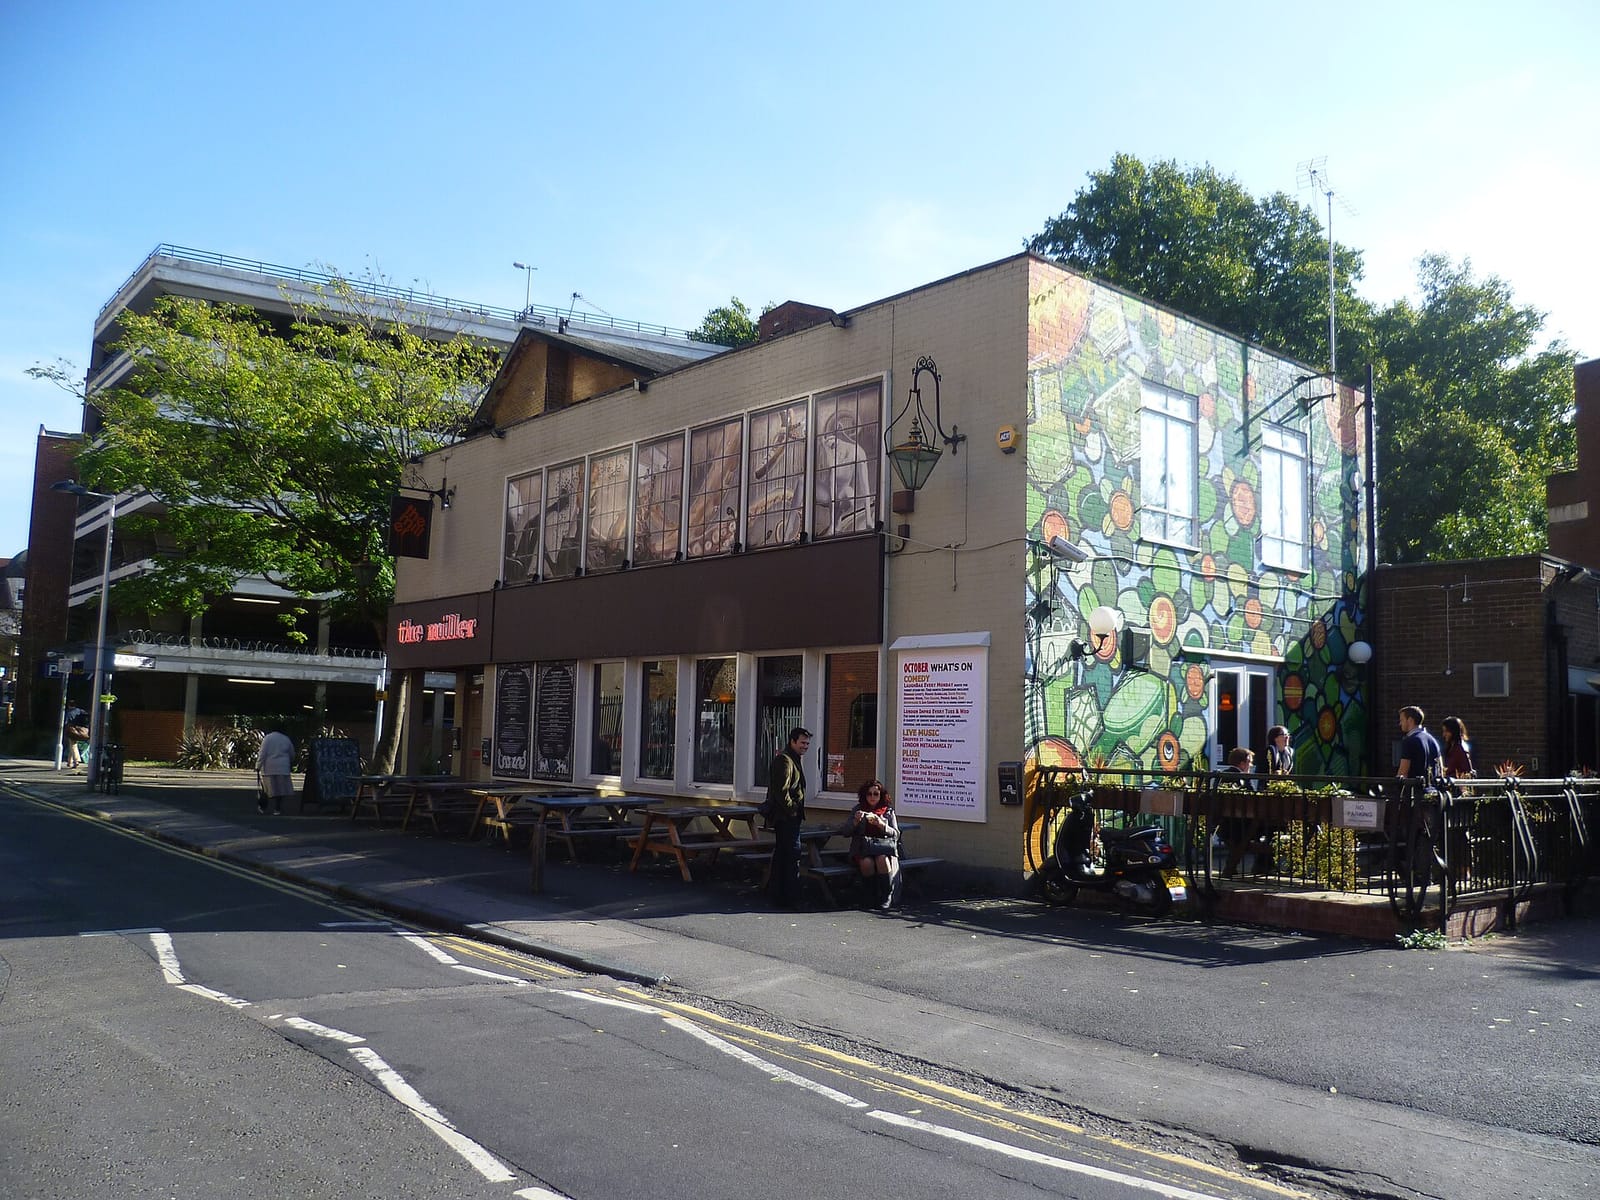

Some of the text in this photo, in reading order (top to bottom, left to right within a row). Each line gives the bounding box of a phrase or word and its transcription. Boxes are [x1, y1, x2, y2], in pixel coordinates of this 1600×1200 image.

[398, 613, 477, 643] the miller
[904, 662, 973, 673] OCTOBER WHAT'S ON
